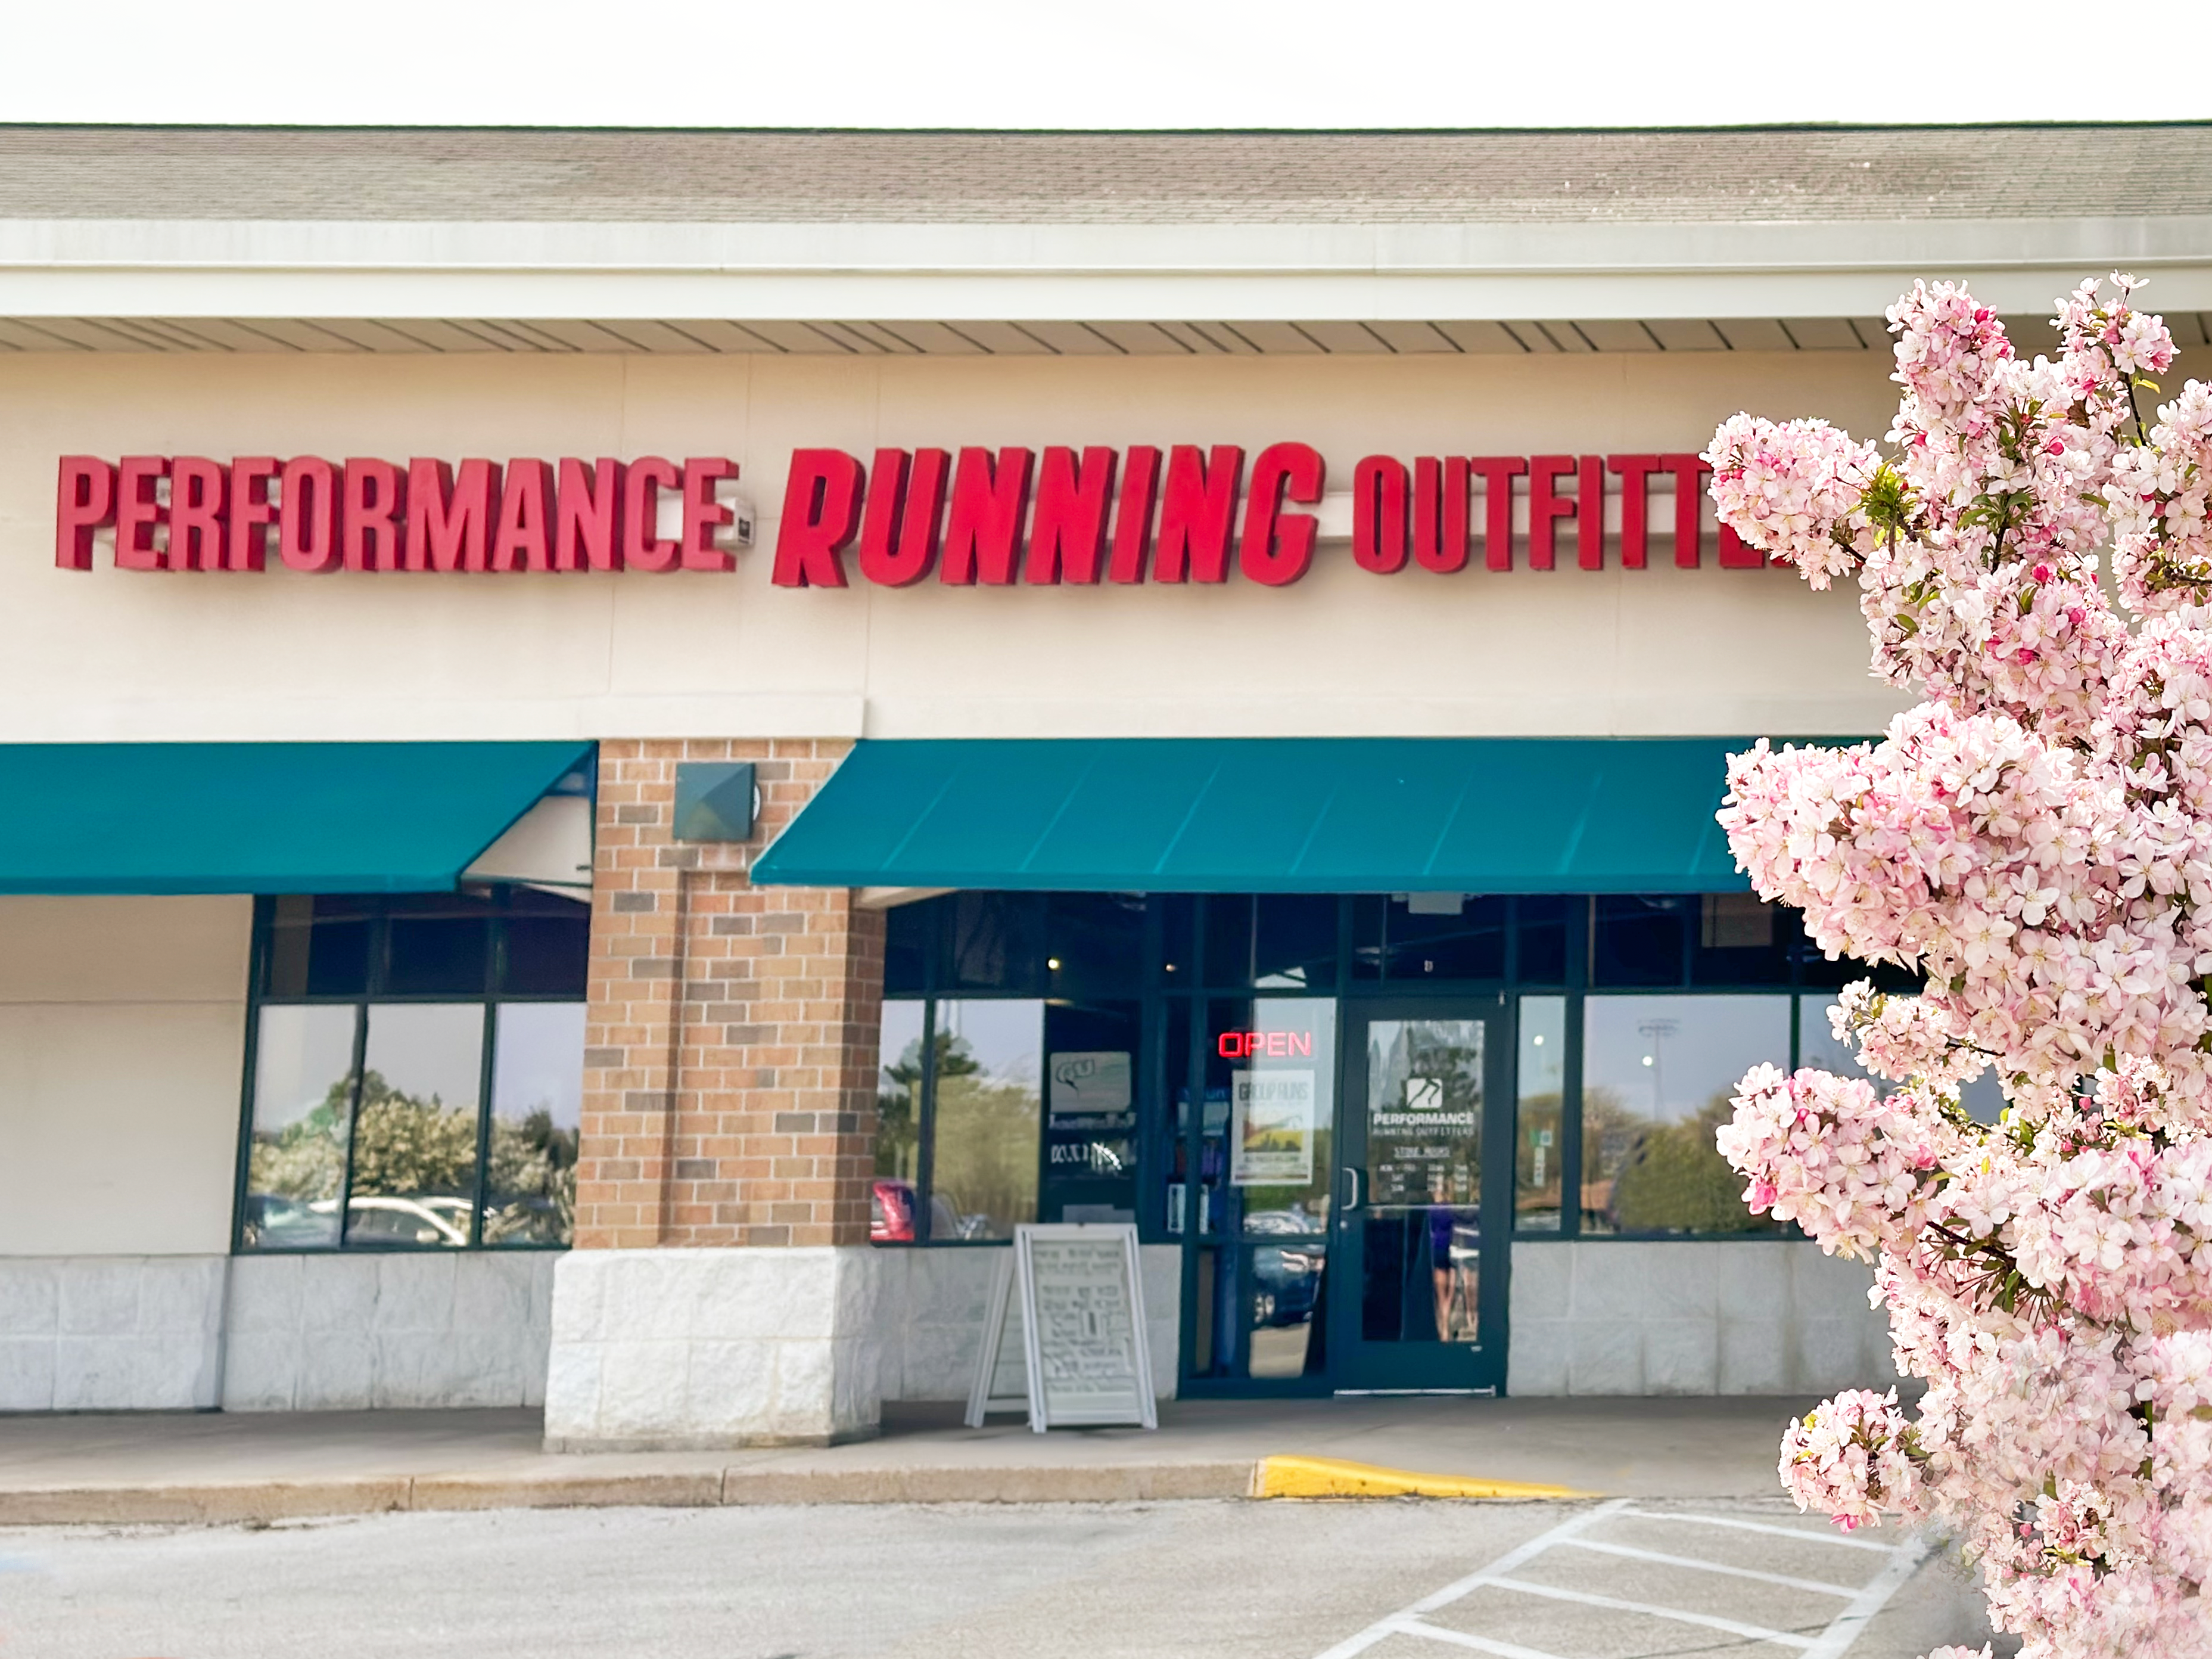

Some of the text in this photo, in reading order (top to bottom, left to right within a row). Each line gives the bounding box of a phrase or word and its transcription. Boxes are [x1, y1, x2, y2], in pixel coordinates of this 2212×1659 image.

[55, 442, 1796, 587] PERFORMANCE RUNNING OUTFITT
[1218, 1032, 1311, 1058] OPEN
[1373, 1112, 1474, 1125] PERFORMANCE
